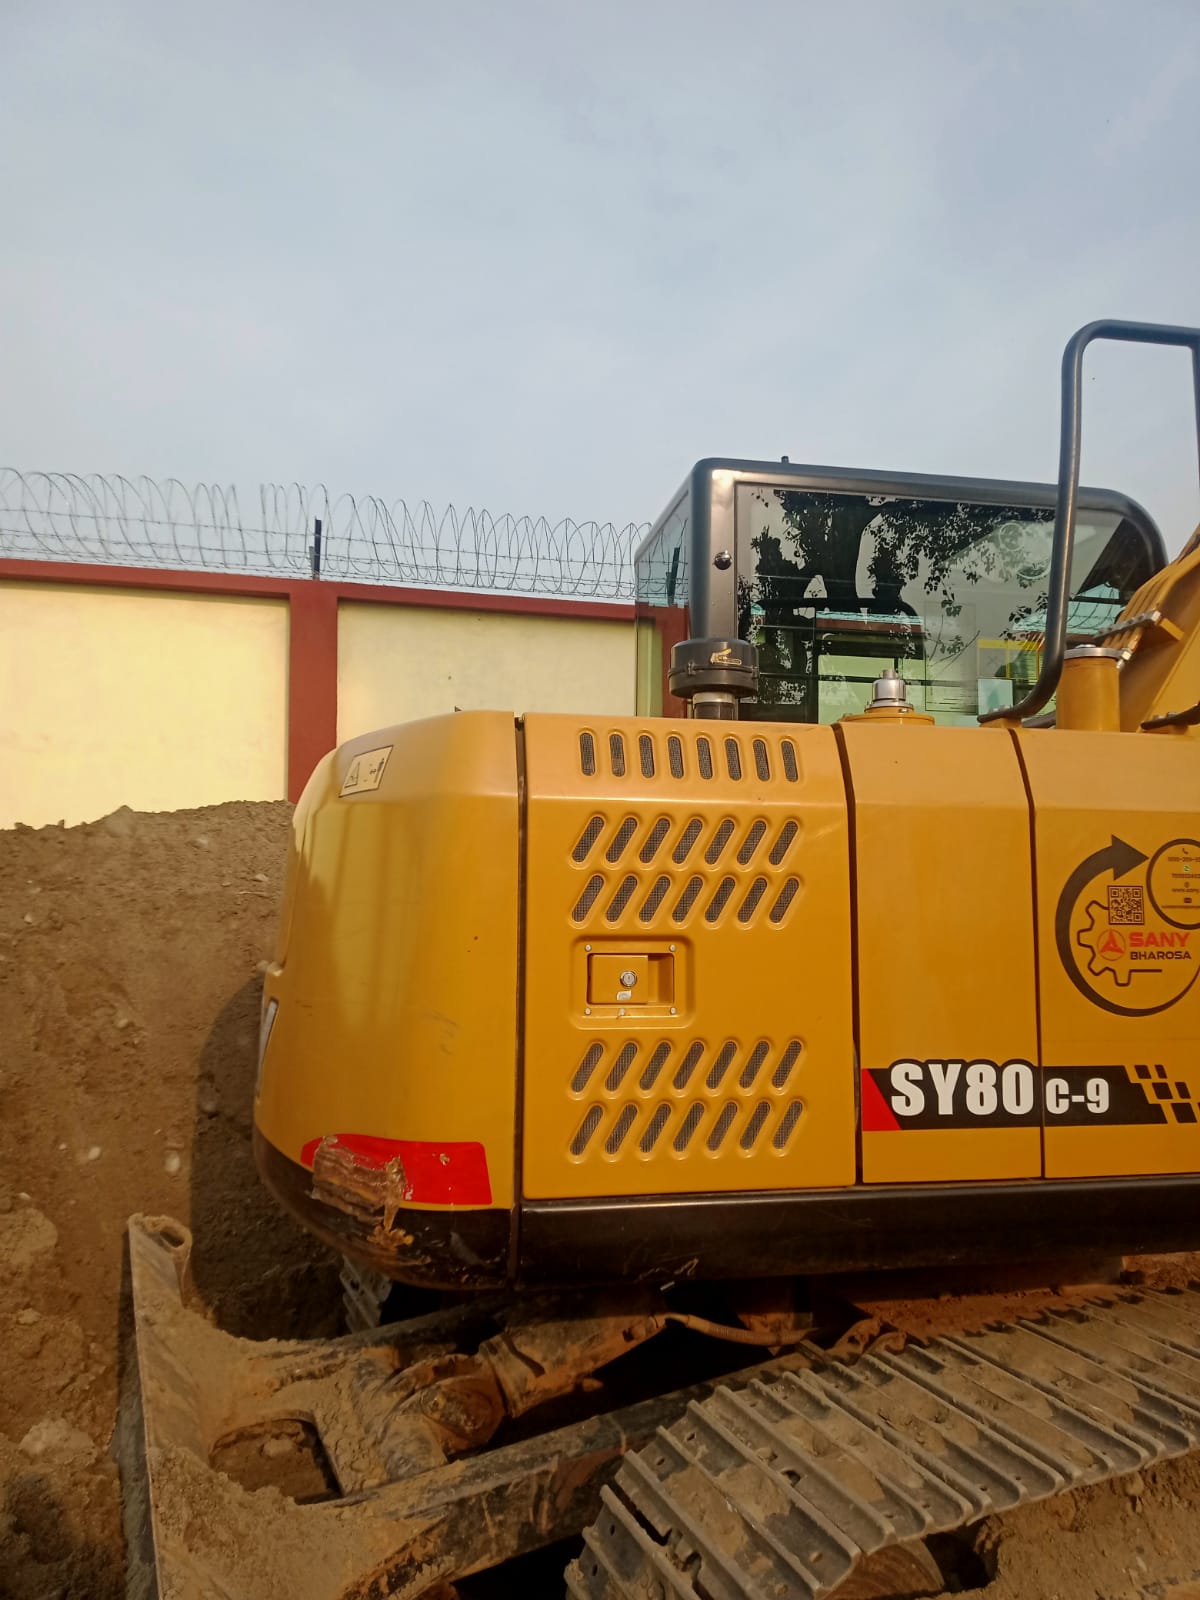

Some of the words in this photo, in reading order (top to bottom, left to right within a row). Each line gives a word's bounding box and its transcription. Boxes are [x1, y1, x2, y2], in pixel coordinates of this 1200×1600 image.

[1129, 931, 1190, 947] SANY
[1130, 951, 1192, 960] BHAROSA
[890, 1062, 1034, 1117] SY80
